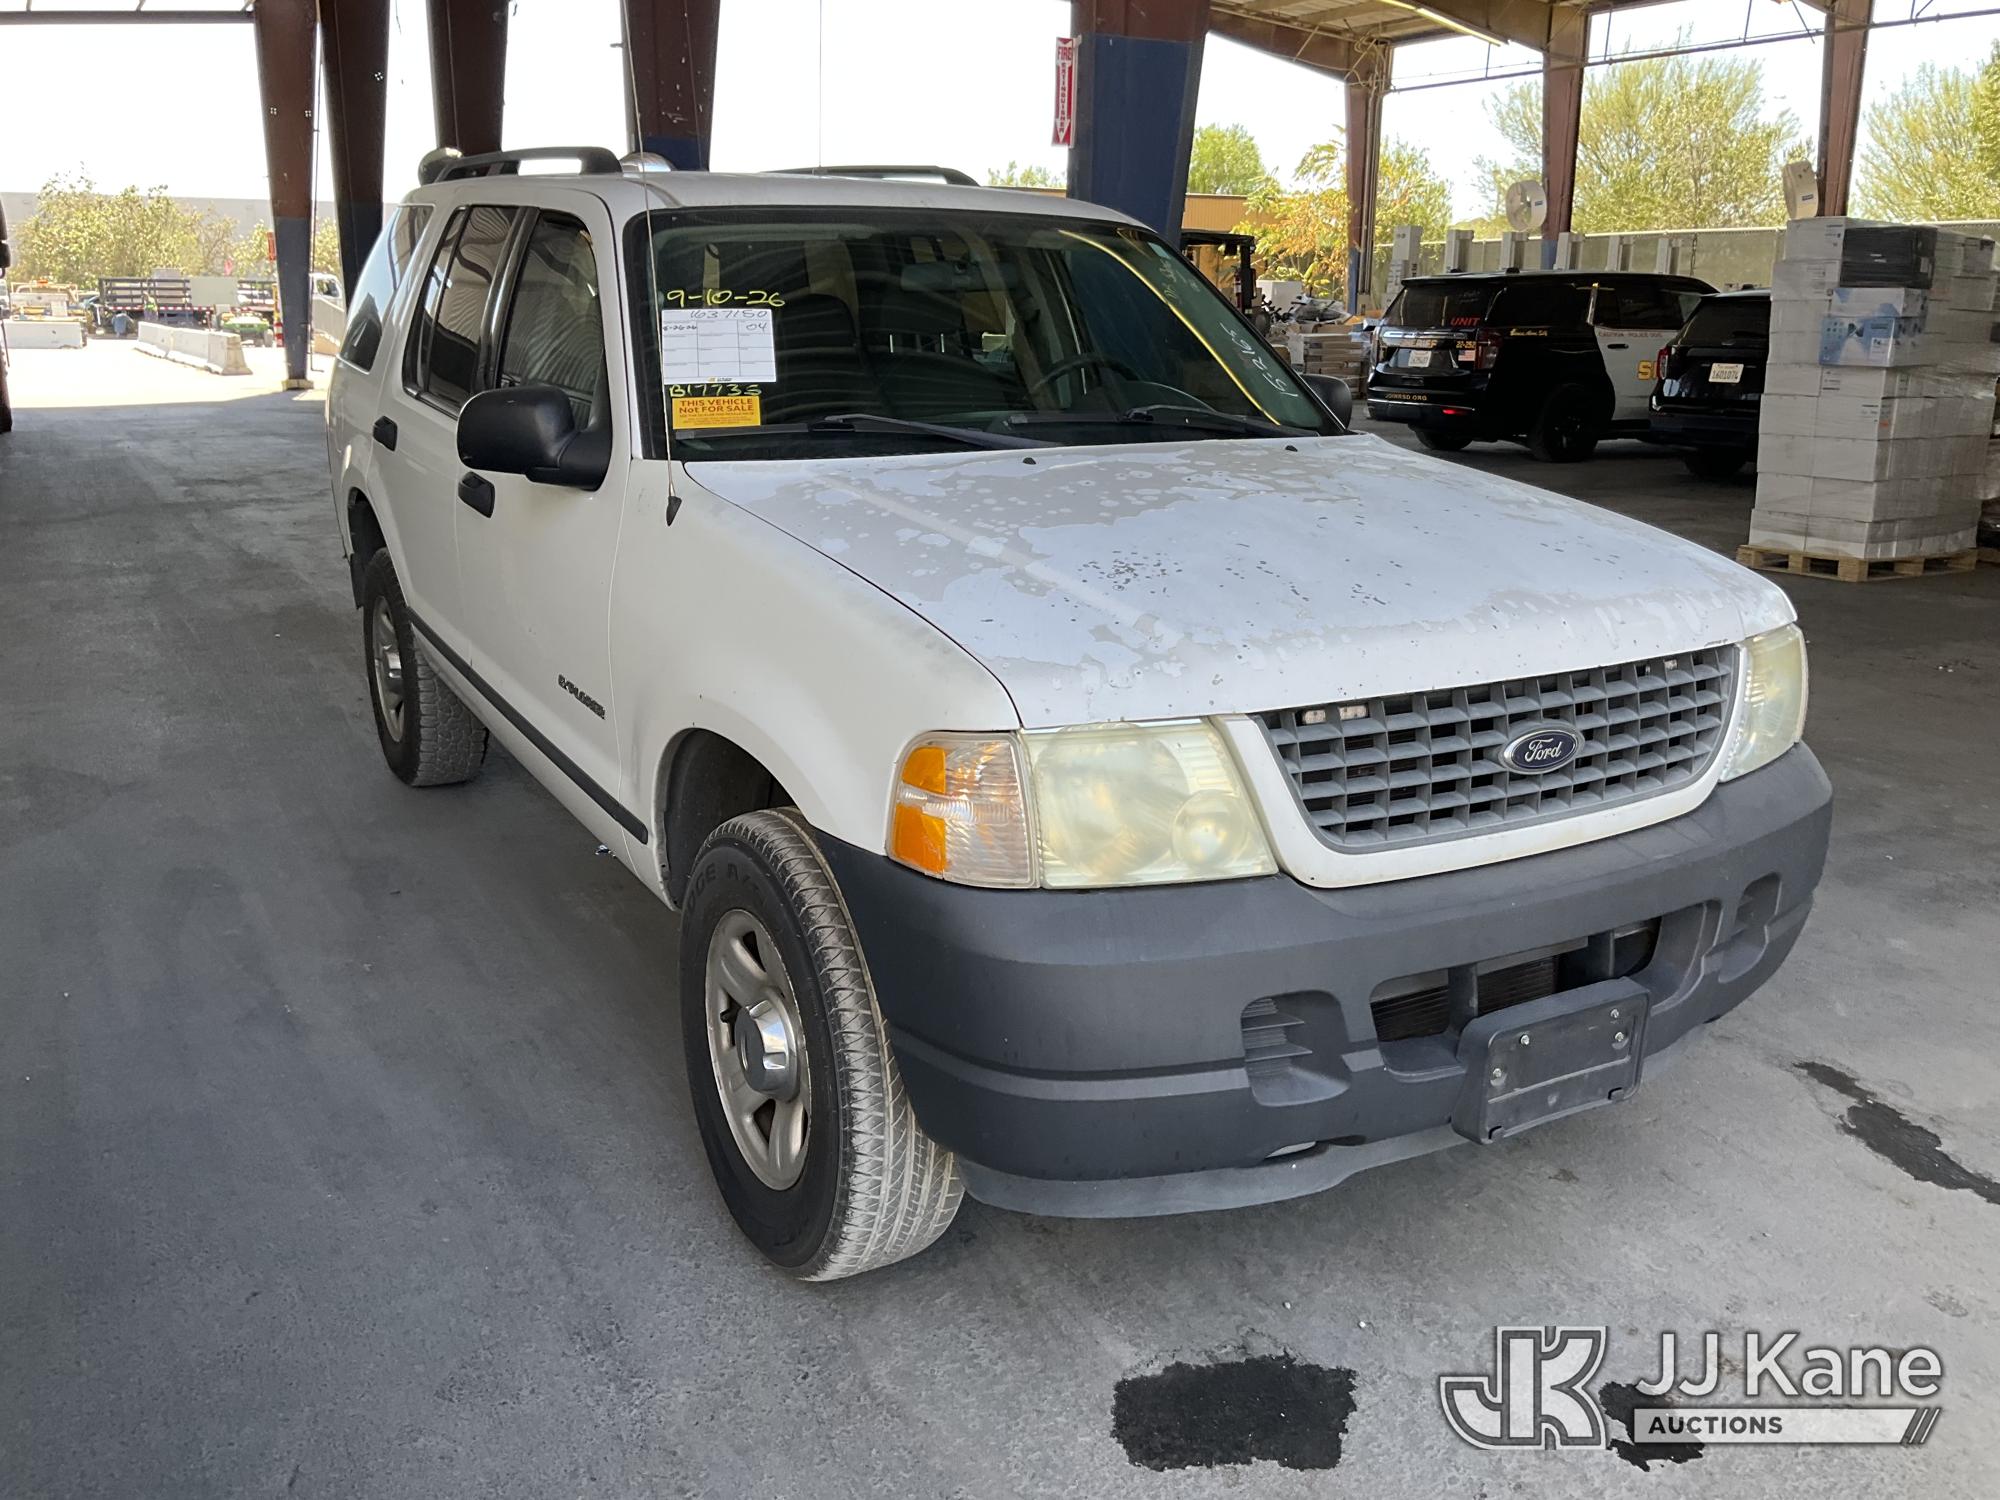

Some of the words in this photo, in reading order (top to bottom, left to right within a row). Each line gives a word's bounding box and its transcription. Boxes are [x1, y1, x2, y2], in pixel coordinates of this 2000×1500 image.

[667, 289, 785, 308] 9-10-26
[1450, 317, 1480, 326] UNIT
[680, 399, 704, 407] THIS
[707, 398, 753, 406] VEHICLE
[1524, 738, 1563, 762] Ford
